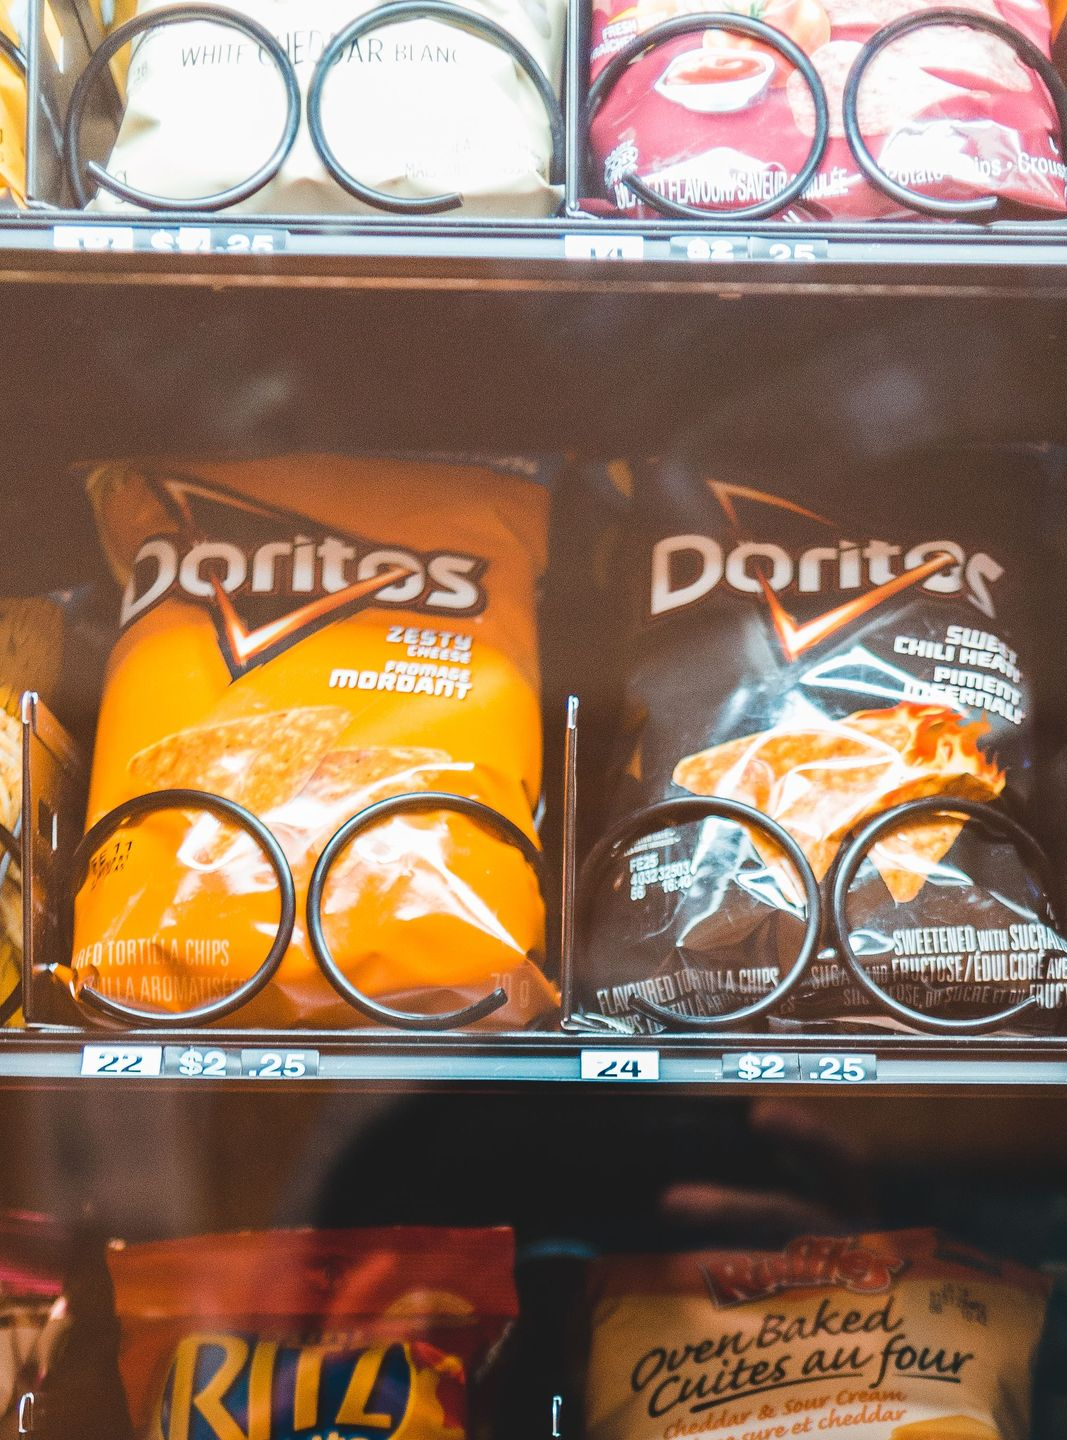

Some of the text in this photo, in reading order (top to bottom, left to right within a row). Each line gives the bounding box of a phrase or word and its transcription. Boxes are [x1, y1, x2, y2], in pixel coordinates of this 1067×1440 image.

[121, 534, 480, 628] Doritos
[651, 533, 1004, 619] Doritos
[386, 625, 473, 650] ZESTY
[893, 635, 955, 662] CHILI
[407, 644, 472, 664] CHEESE
[329, 668, 474, 700] MORDANT
[384, 660, 471, 682] FROMAGE
[186, 939, 230, 968] CHIPS
[893, 924, 977, 956] SWEETENED
[976, 928, 1010, 952] WITH
[738, 966, 780, 994] CHIPS
[97, 1048, 306, 1077] 22 $2 .25
[596, 1052, 866, 1081] 24 $2 .25
[631, 1332, 754, 1394] Oven
[755, 1295, 905, 1349] Baked
[648, 1333, 976, 1418] Cuites au four
[790, 1416, 813, 1435] et
[817, 1403, 908, 1429] cheddar
